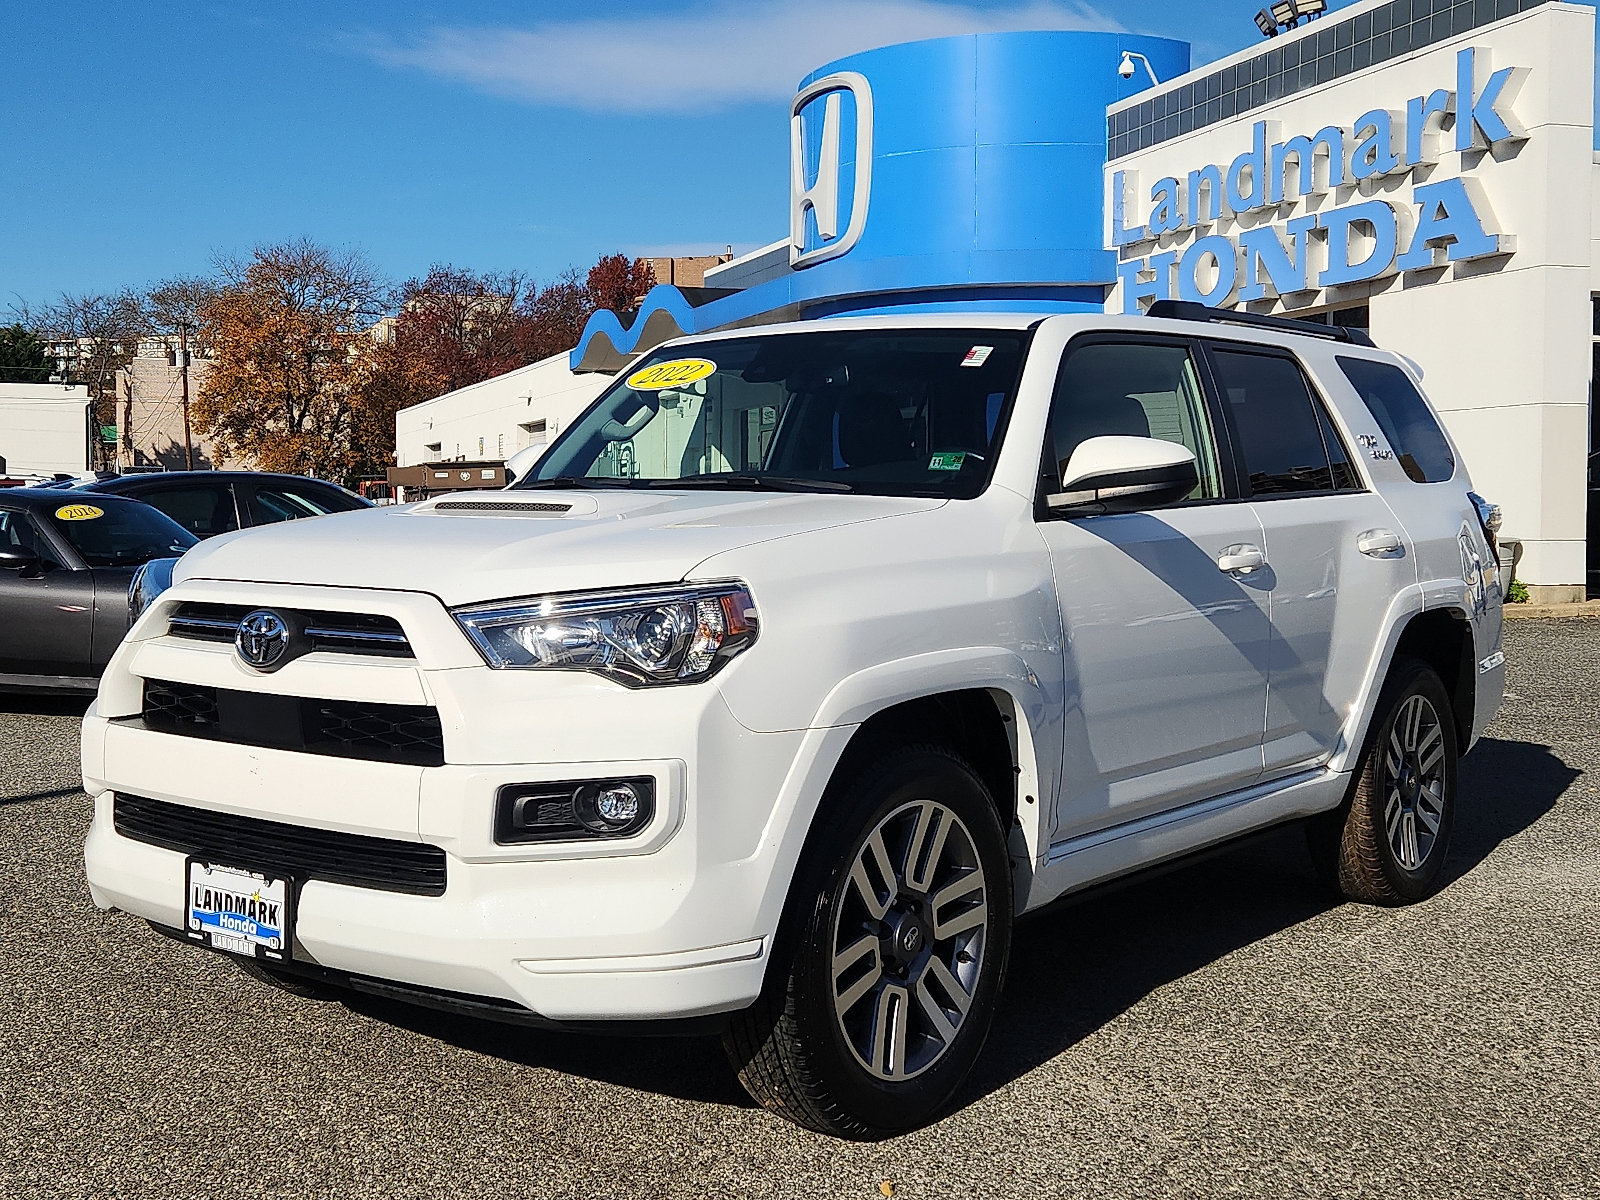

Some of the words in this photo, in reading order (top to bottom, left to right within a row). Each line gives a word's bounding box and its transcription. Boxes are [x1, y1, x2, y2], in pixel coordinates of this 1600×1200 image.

[1113, 46, 1518, 246] Landmark
[1118, 176, 1505, 316] HONDA
[635, 364, 705, 385] 2022
[65, 506, 98, 519] 2014
[194, 886, 279, 926] LANDMARK
[219, 914, 258, 934] Honda
